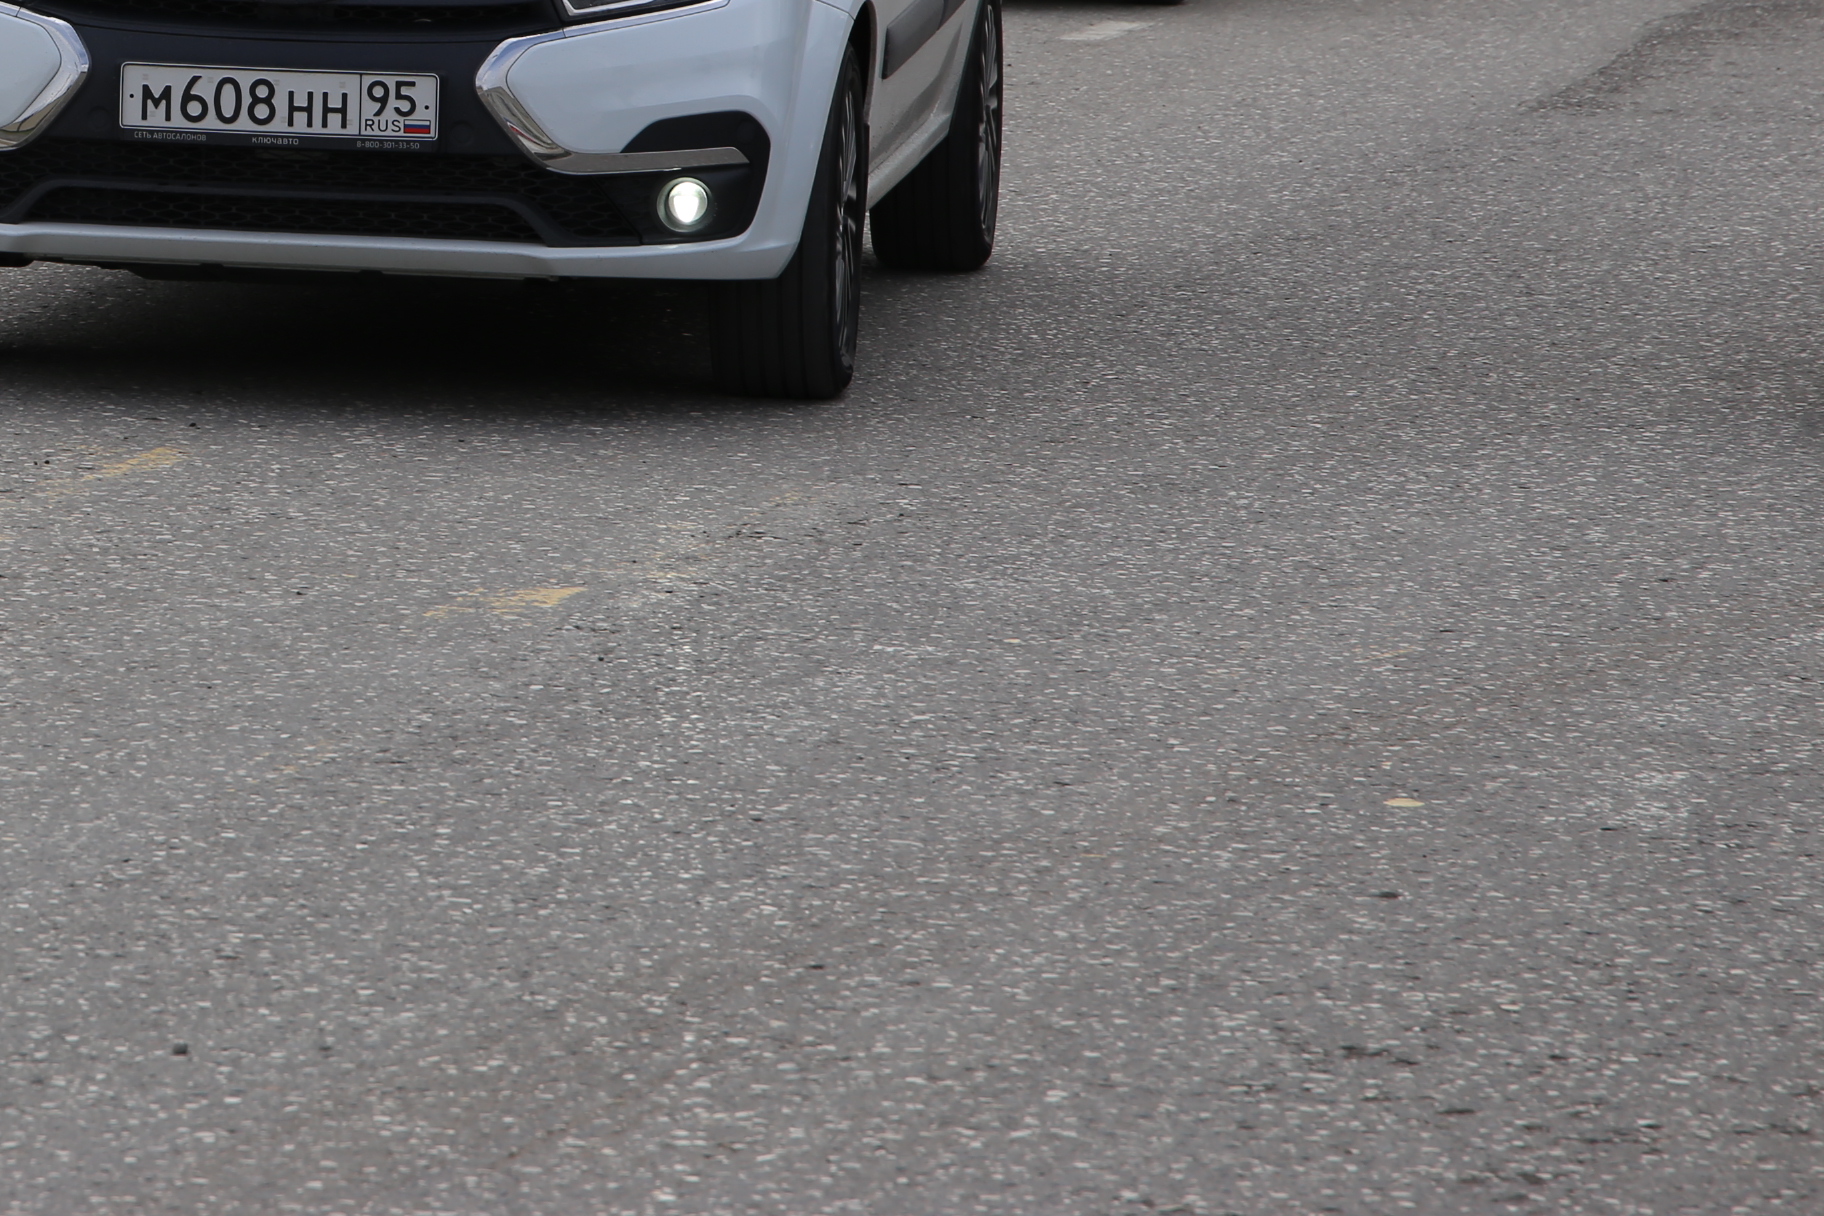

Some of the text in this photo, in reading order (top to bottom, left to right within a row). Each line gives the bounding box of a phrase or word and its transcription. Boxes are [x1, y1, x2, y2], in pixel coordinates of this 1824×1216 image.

[141, 75, 416, 129] М608НН 95
[364, 119, 401, 132] RUS
[134, 131, 207, 141] СЕТЬ АВТОСАЛОНОВ
[356, 140, 420, 149] 8-800-301-33-50
